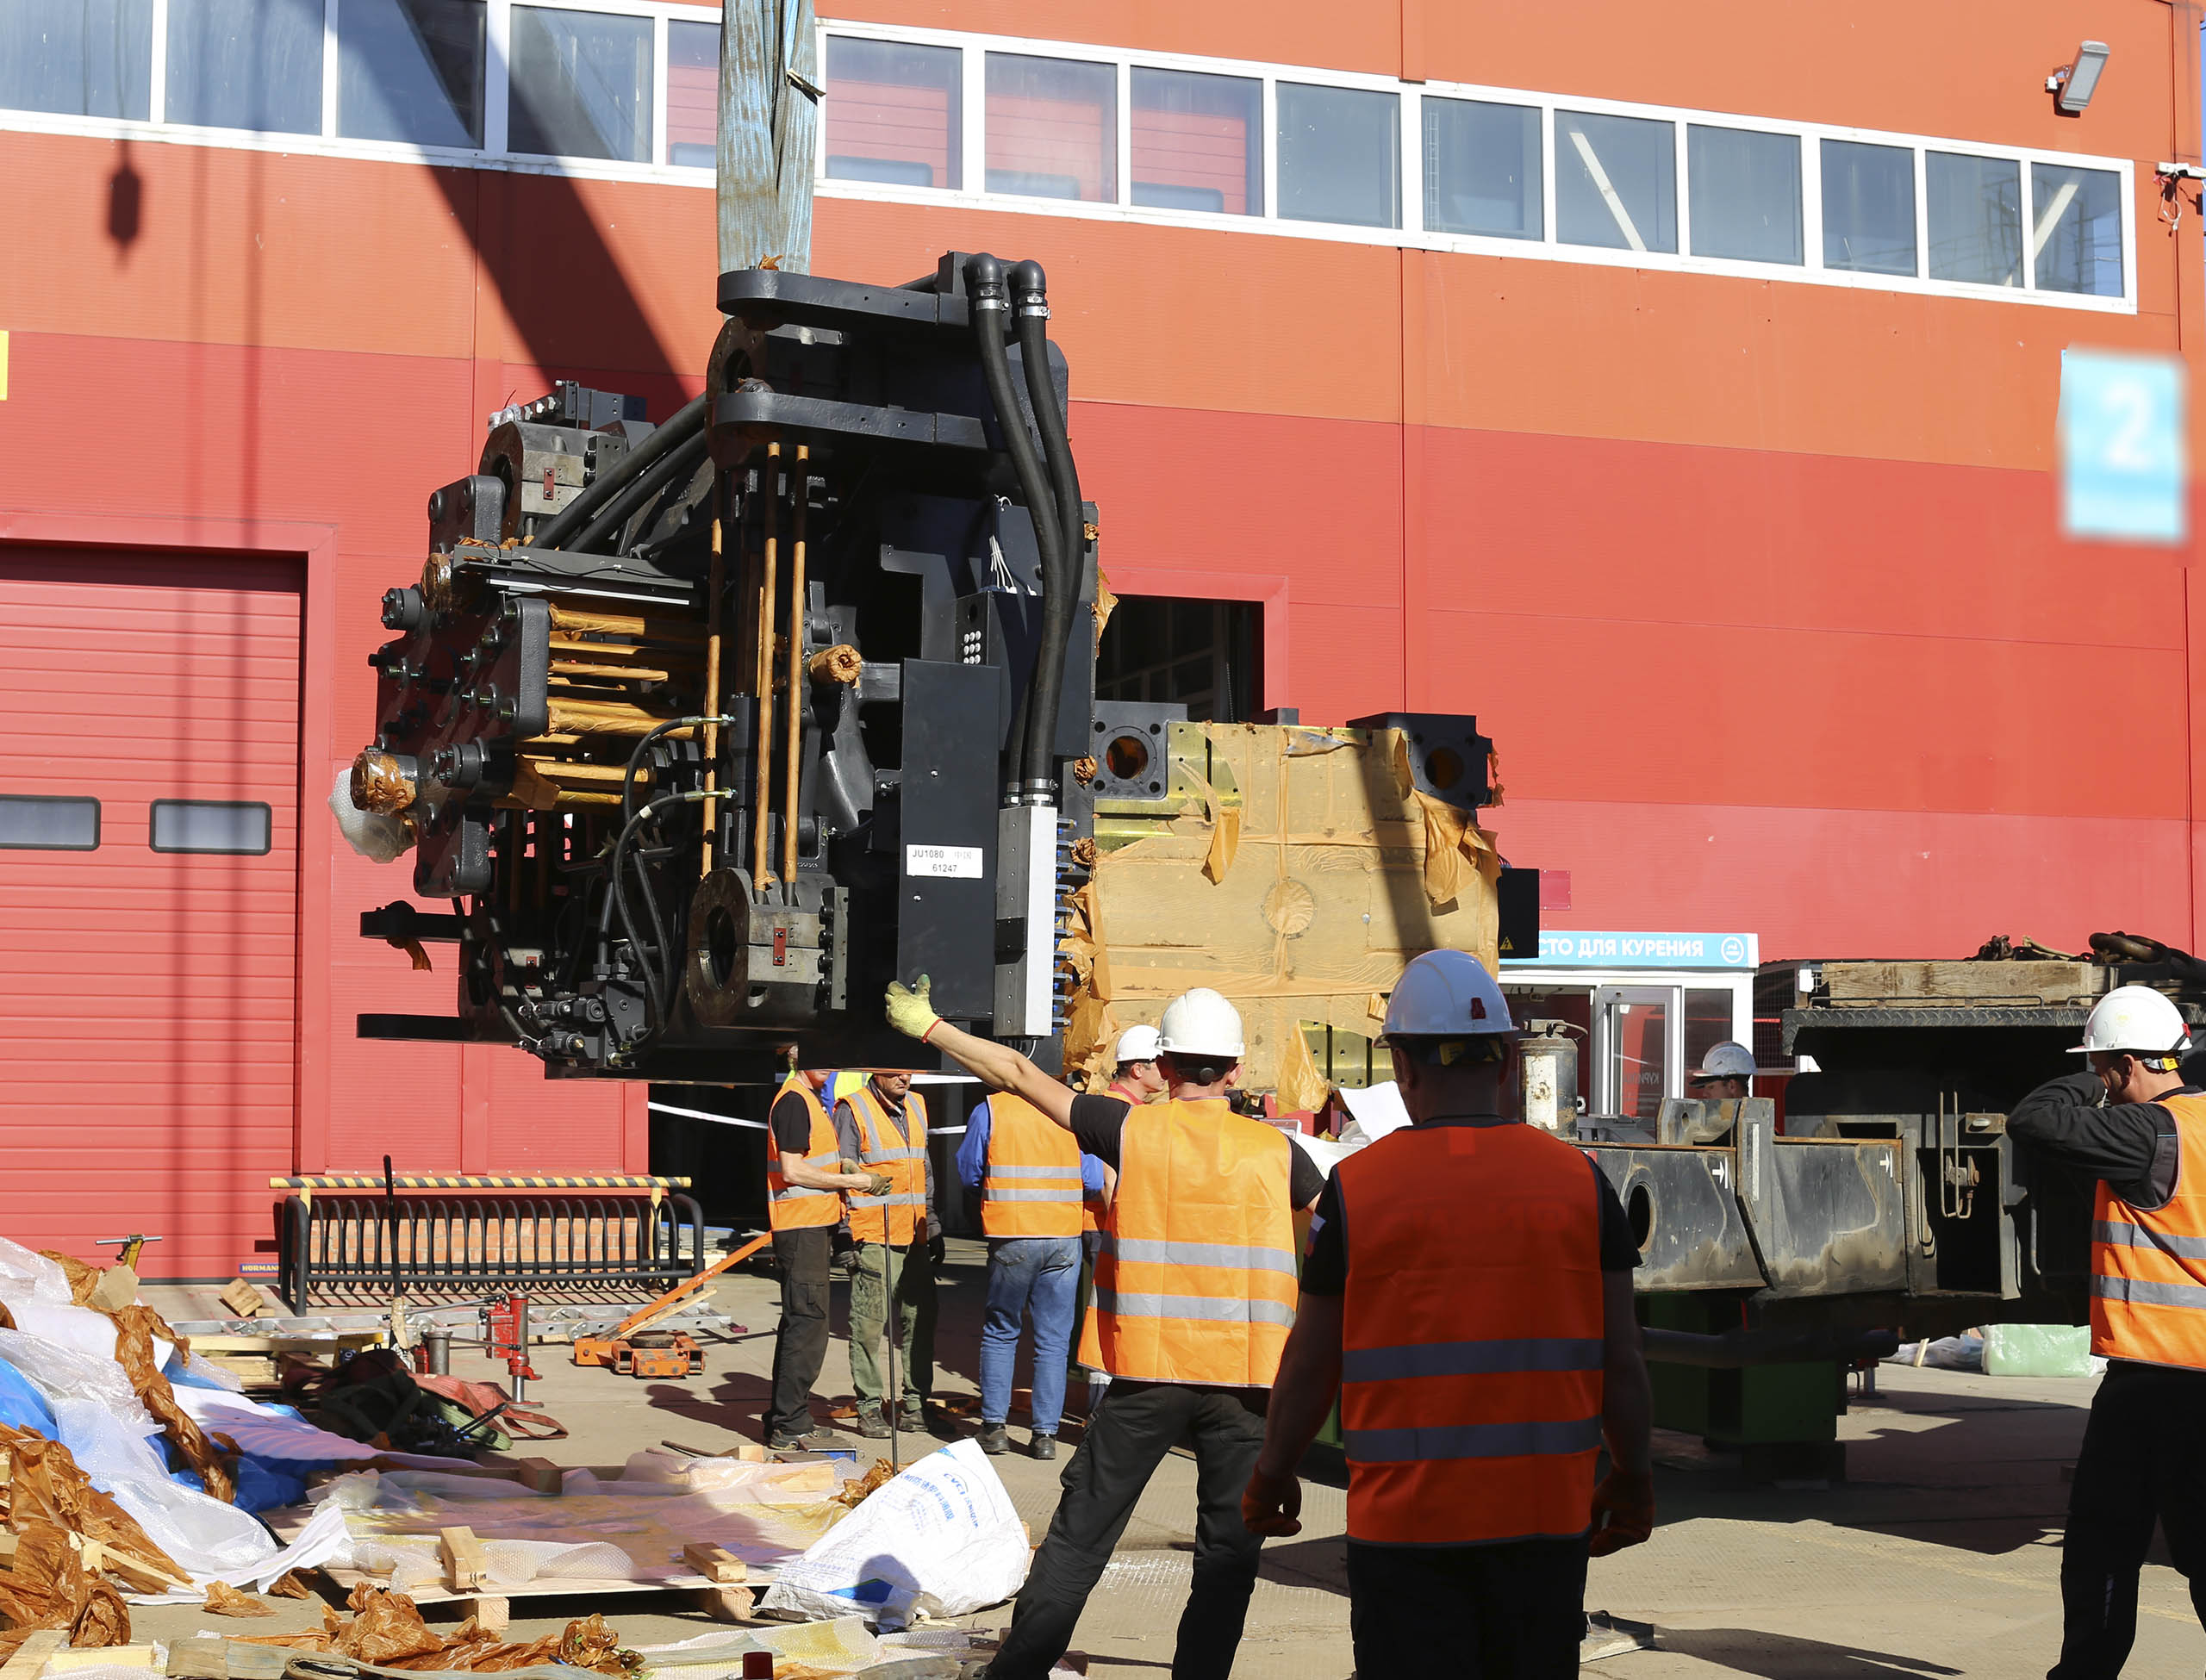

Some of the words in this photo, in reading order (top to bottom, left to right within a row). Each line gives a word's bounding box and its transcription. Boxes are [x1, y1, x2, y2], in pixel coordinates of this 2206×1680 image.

[2099, 380, 2152, 470] 2
[912, 849, 944, 858] JU1080
[932, 863, 957, 873] 61247
[1578, 938, 1616, 959] ДЛЯ
[1621, 939, 1704, 957] КУРЕНИЯ
